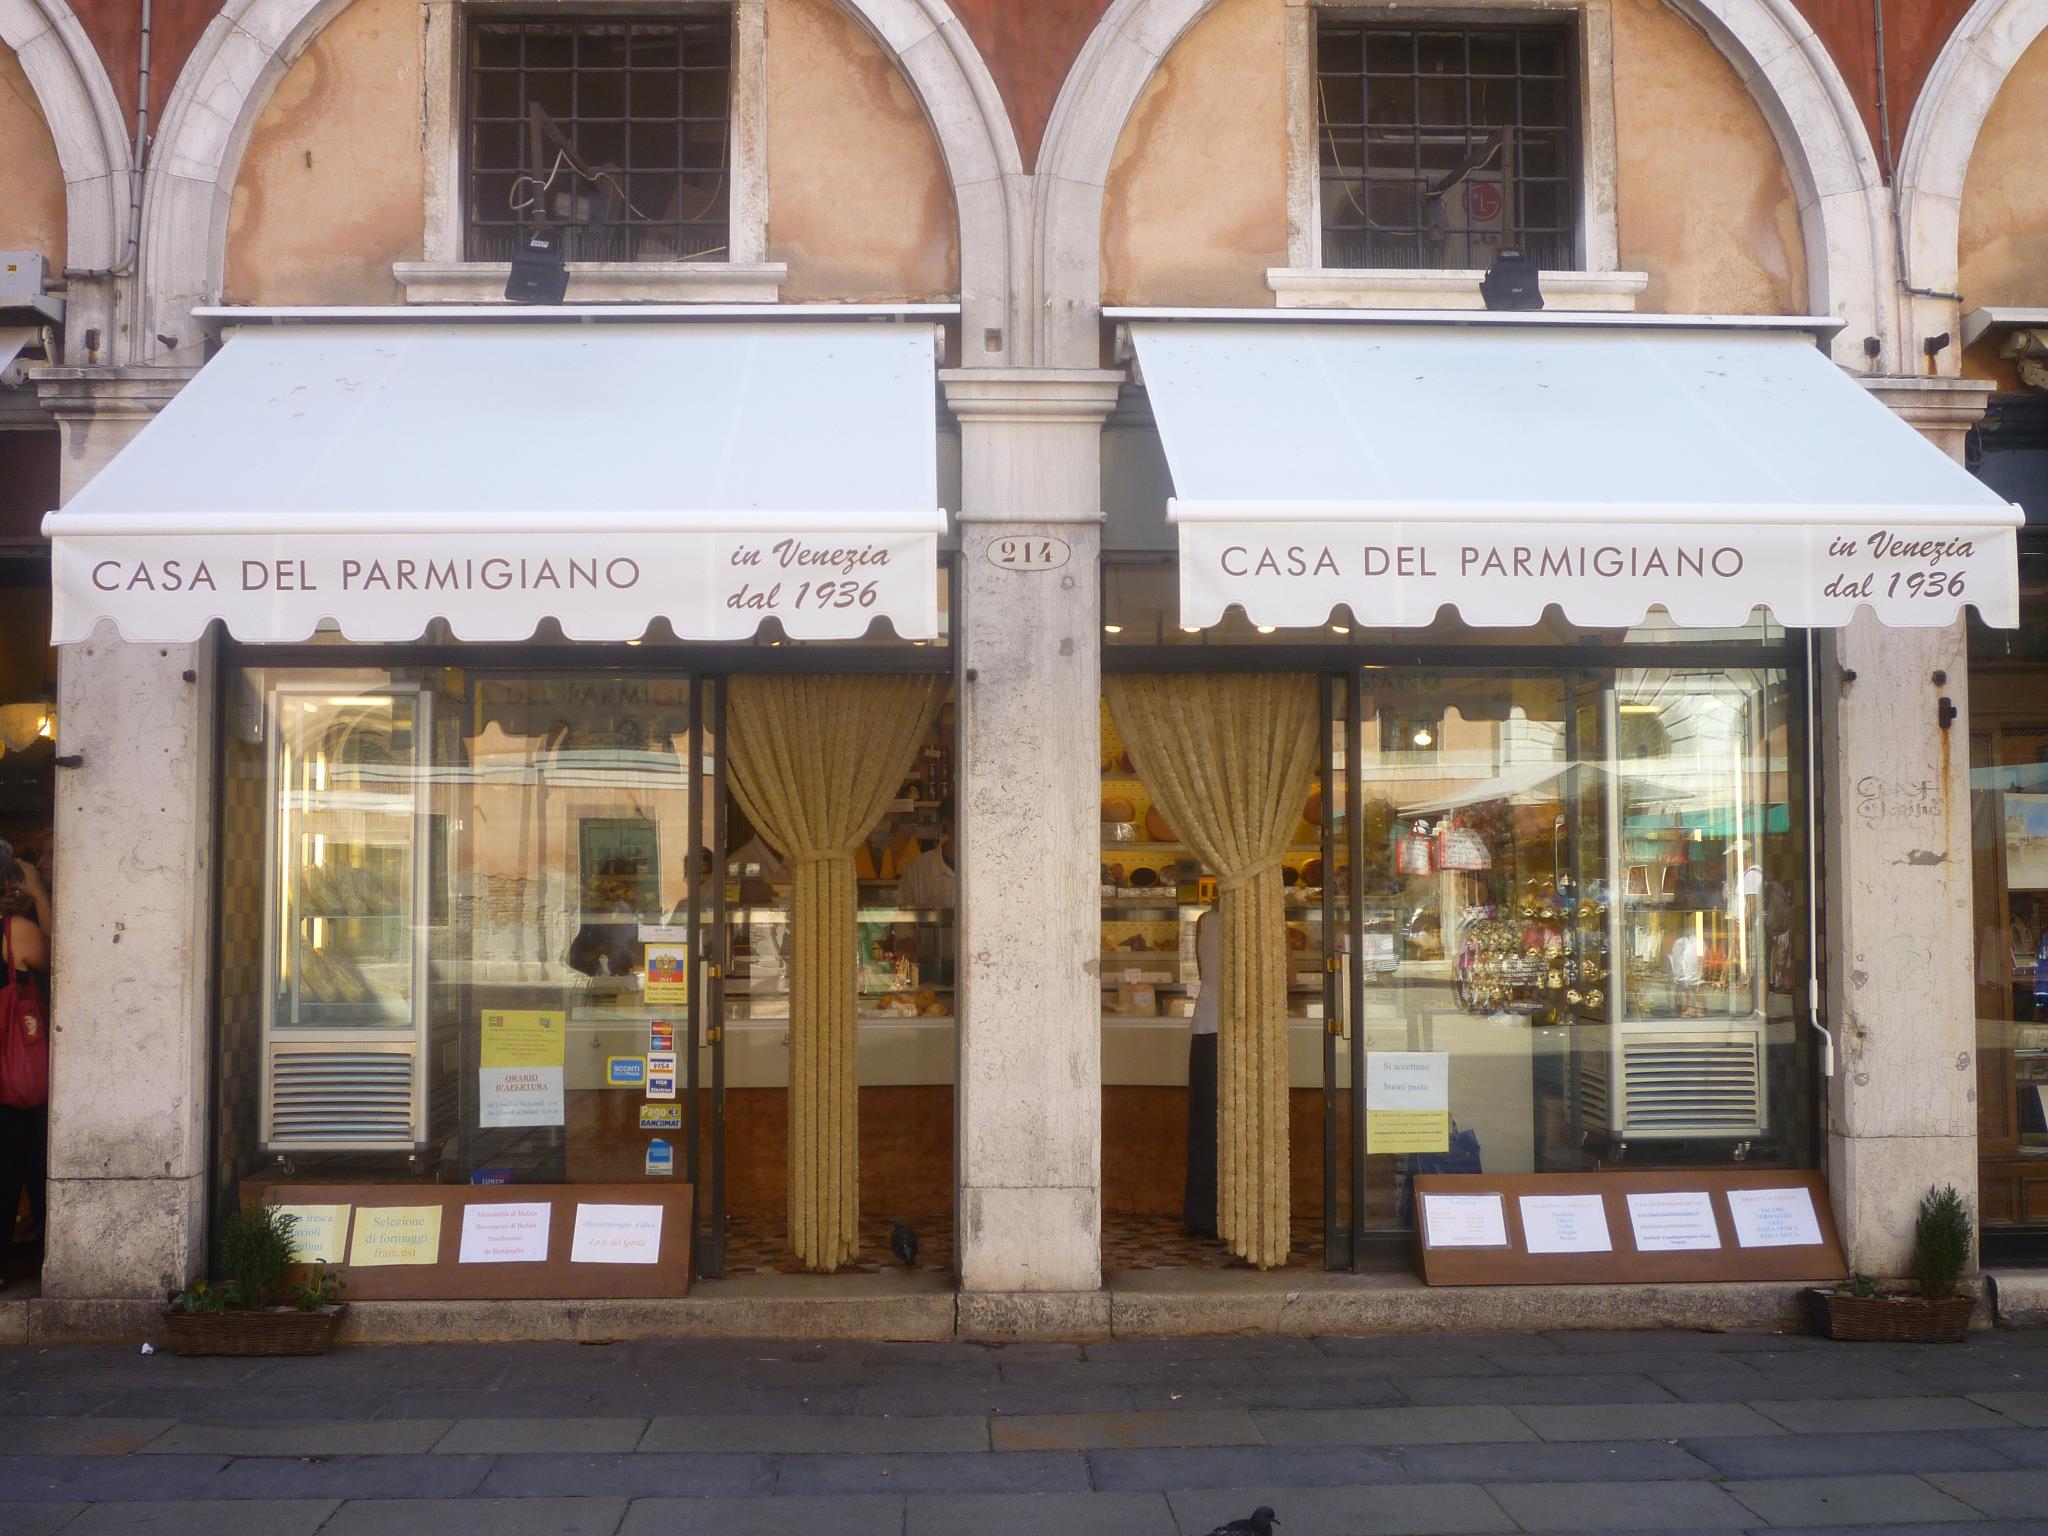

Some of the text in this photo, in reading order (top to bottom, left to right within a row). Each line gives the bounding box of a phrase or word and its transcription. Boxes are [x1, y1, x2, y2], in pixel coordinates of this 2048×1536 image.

[731, 538, 890, 575] in Venezia
[1000, 541, 1053, 563] 214
[1828, 530, 1975, 567] in Venezia
[1221, 546, 1744, 578] CASA DEL PARMIGIANO
[92, 558, 639, 591] CASA DEL PARMIGIANO
[1824, 571, 1966, 598] dal 1936
[727, 581, 879, 609] dal 1936
[505, 1074, 539, 1082] ORARIO
[641, 1105, 666, 1119] Pago
[640, 1119, 680, 1127] BANCOMAT
[306, 1214, 333, 1224] fresca
[373, 1217, 425, 1227] Selezione
[365, 1233, 428, 1245] di formaggi
[374, 1248, 416, 1258] francesi
